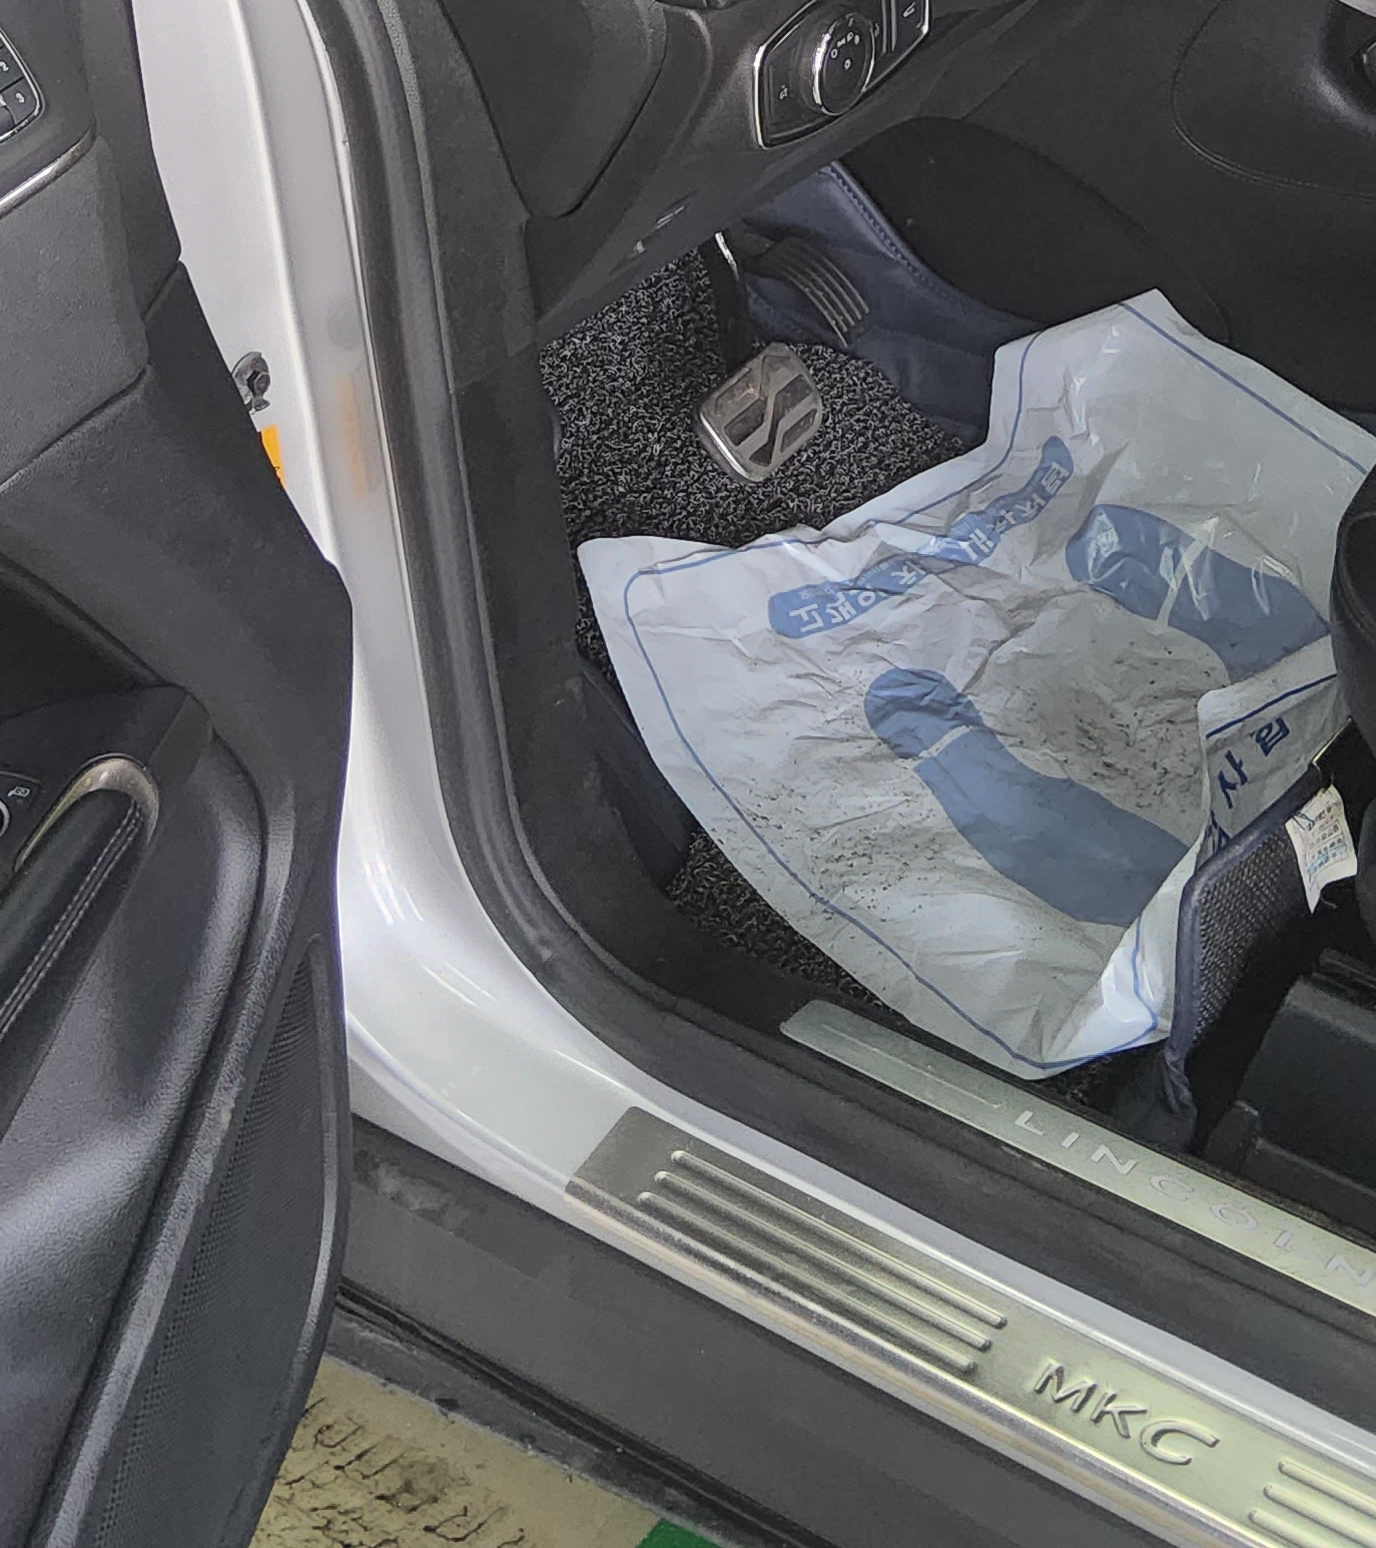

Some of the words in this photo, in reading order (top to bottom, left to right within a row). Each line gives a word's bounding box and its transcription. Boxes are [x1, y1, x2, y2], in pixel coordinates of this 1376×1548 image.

[0, 61, 10, 72] 2
[15, 92, 25, 103] 3
[1014, 1109, 1376, 1288] LINCOLN
[1033, 1358, 1221, 1466] MKC
